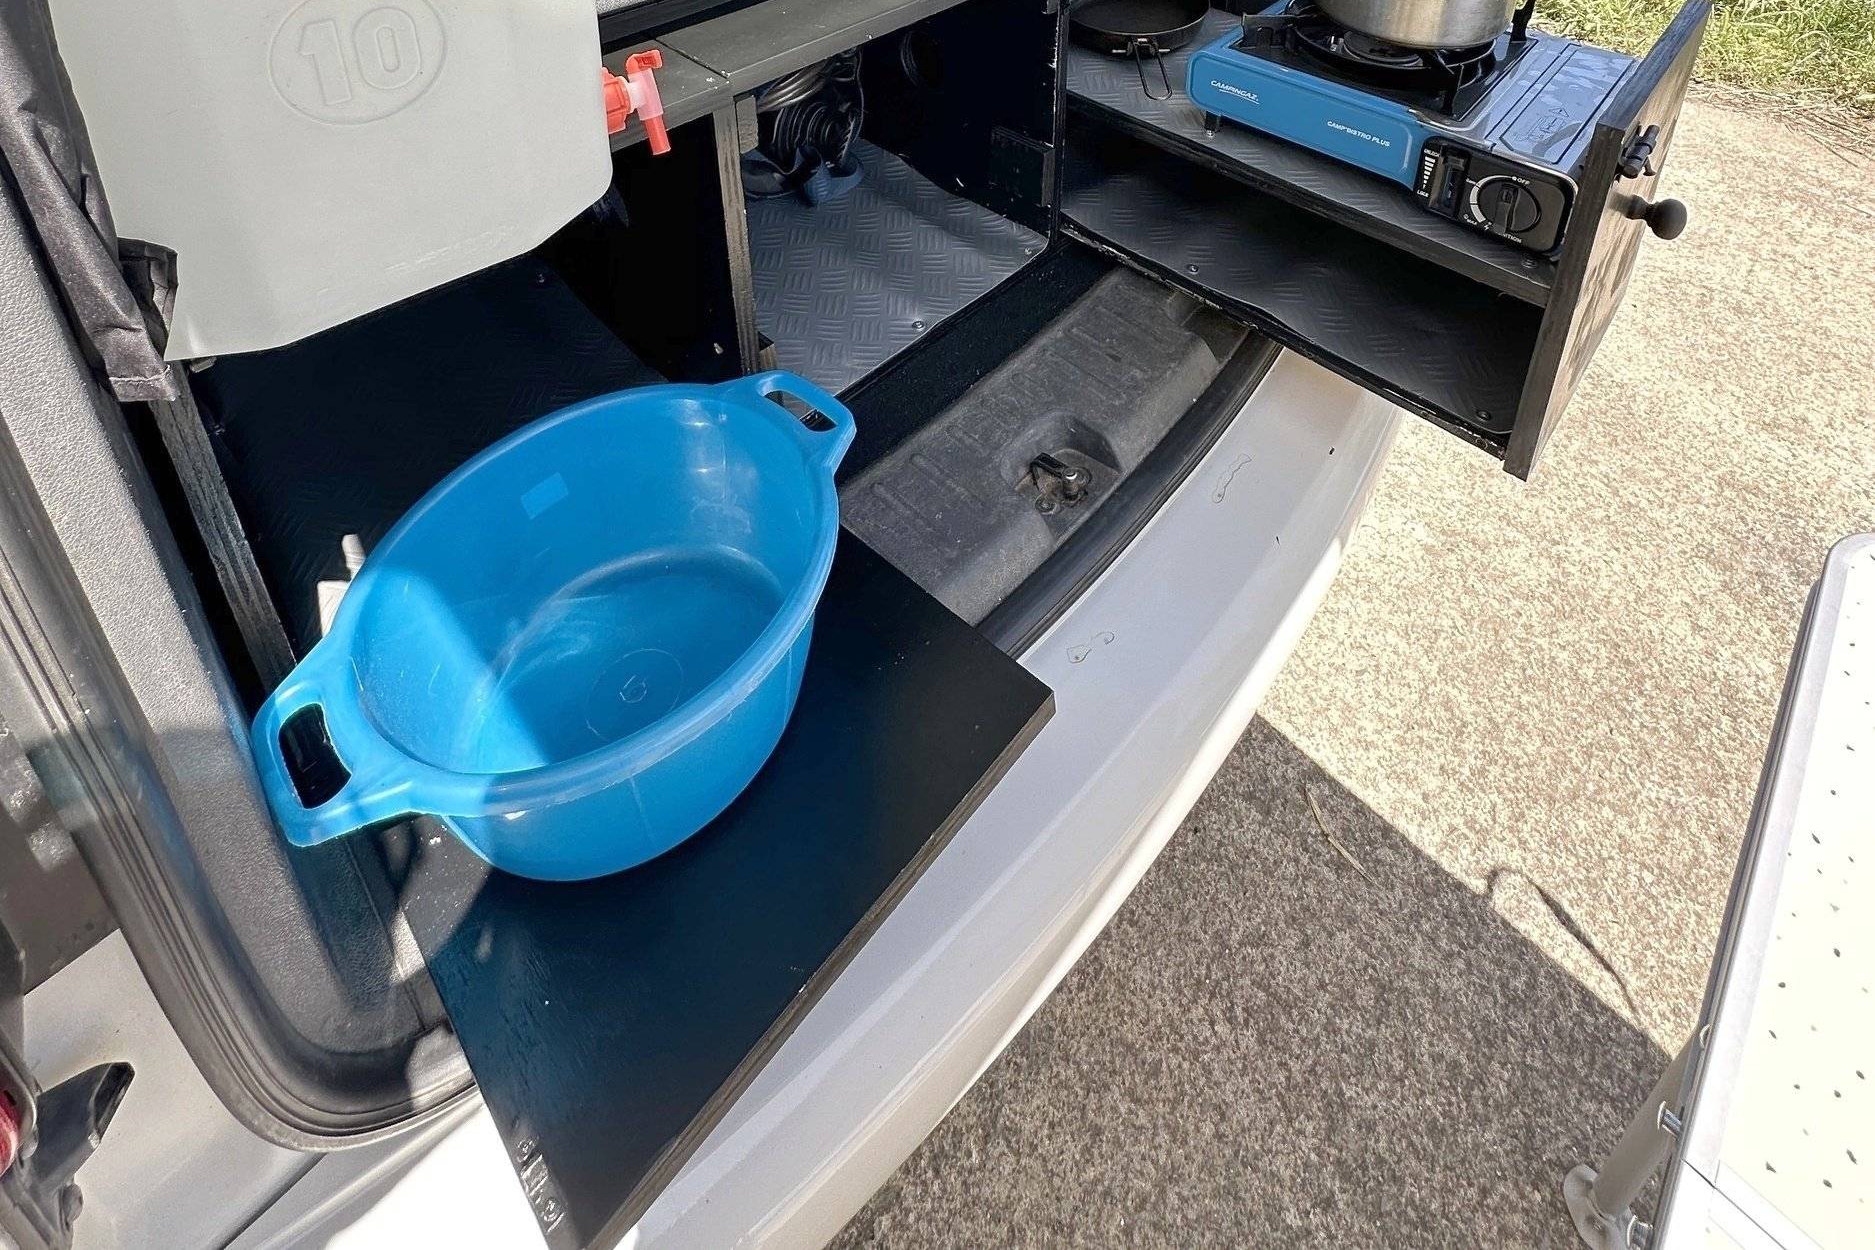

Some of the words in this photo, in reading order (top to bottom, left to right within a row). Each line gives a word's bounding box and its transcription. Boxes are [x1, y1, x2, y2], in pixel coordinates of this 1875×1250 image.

[298, 6, 422, 105] 10
[1371, 135, 1391, 147] PLUS
[1517, 177, 1531, 185] OFF
